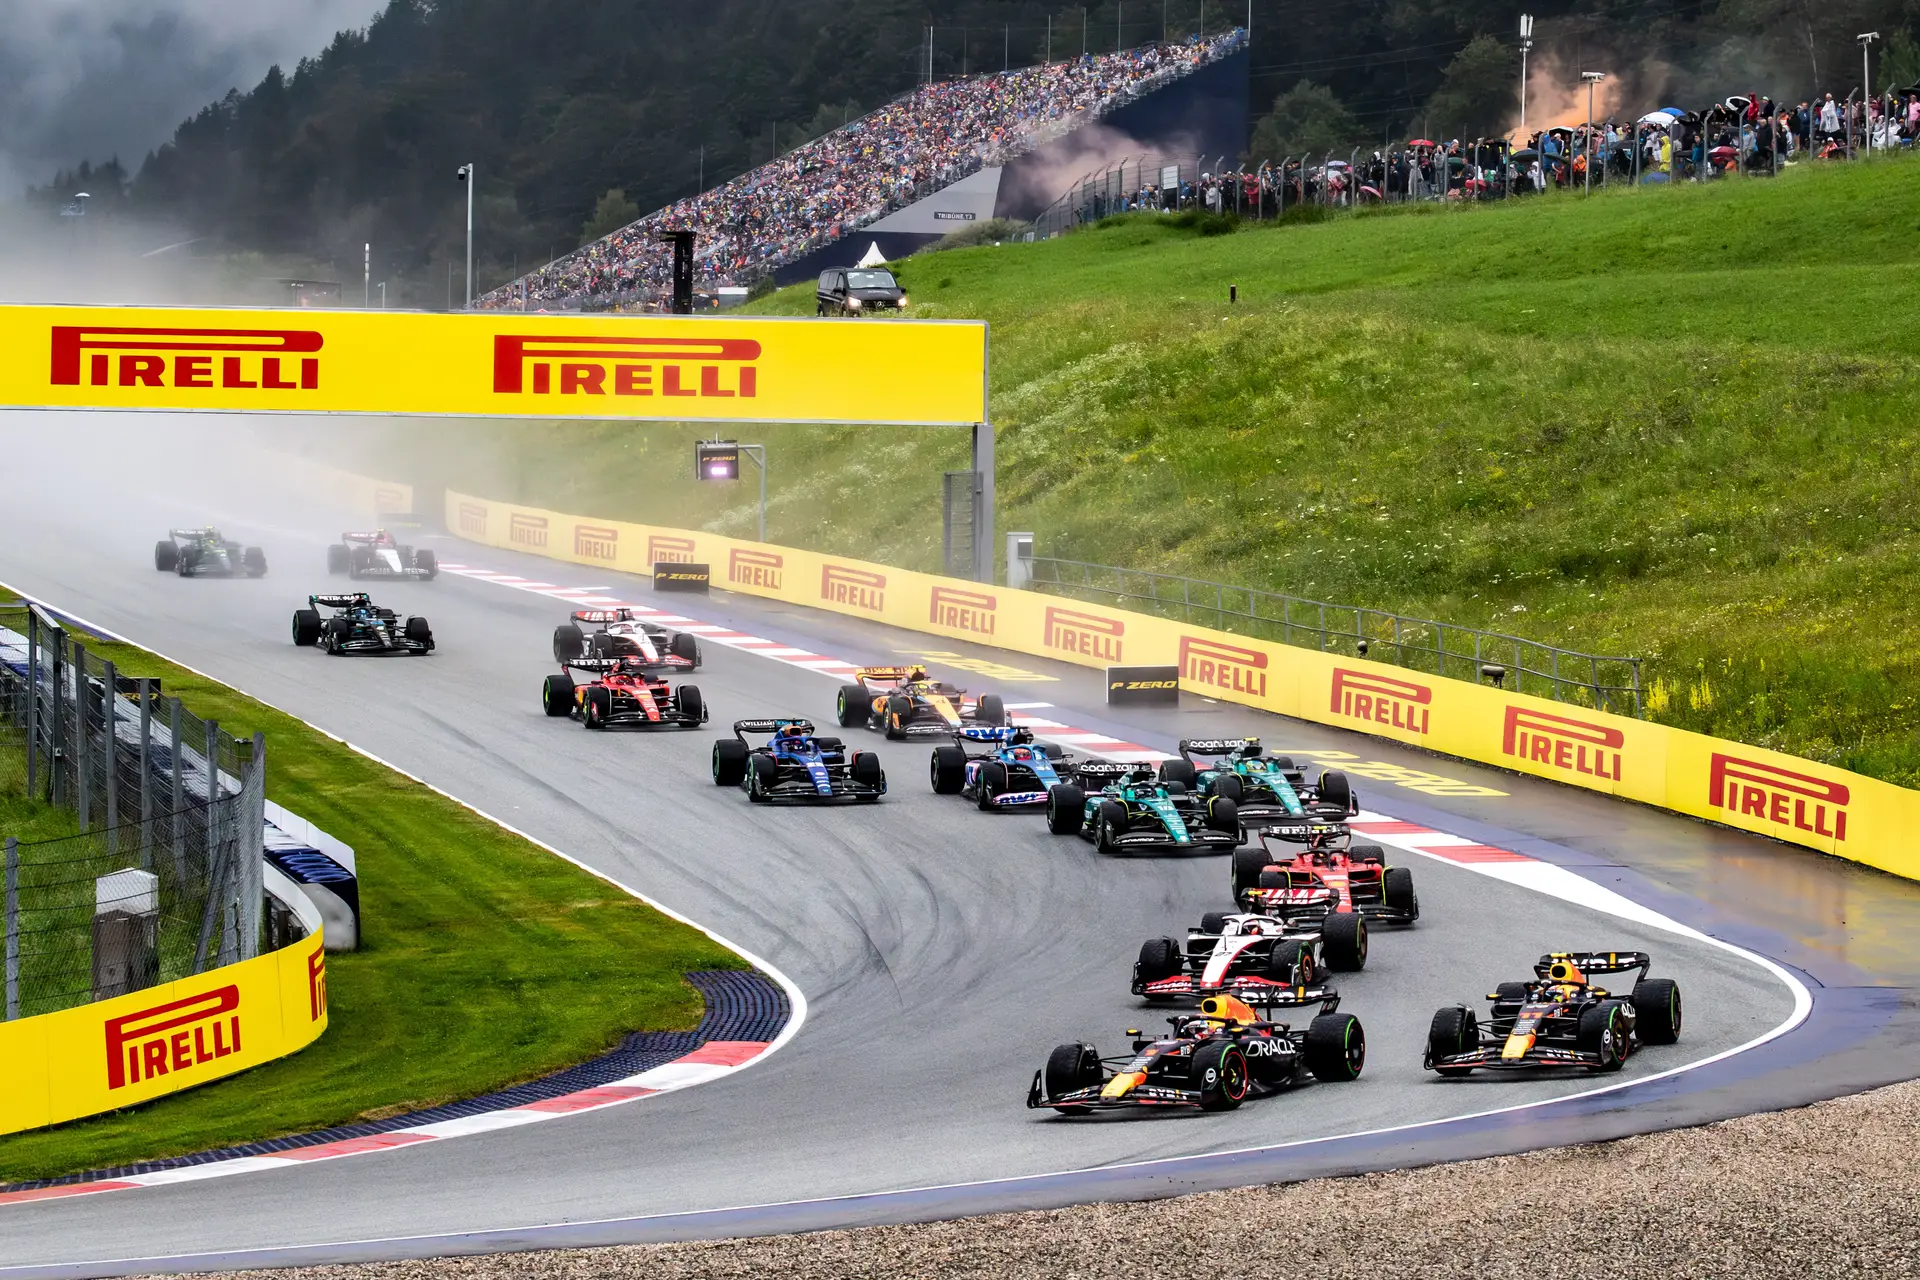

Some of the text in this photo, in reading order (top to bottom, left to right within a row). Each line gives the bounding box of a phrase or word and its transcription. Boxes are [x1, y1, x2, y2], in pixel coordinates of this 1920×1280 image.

[51, 326, 324, 389] PIRELLI
[494, 335, 762, 397] PIRELLI
[510, 513, 549, 548] PIRELLI
[574, 524, 618, 560] PIRELLI
[647, 535, 696, 567] PIRELLI
[729, 547, 783, 590] PIRELLI
[821, 564, 887, 612] PIRELLI
[930, 586, 997, 635] PIRELLI
[1044, 606, 1125, 663] PIRELLI
[1110, 681, 1177, 690] P ZERO
[1178, 635, 1269, 698] PIRELLI
[1330, 667, 1432, 735] PIRELLI
[1503, 705, 1625, 782] PIRELLI
[1311, 760, 1511, 797] ZERO
[1709, 752, 1850, 842] PIRELLI
[104, 984, 241, 1090] PIRELLI
